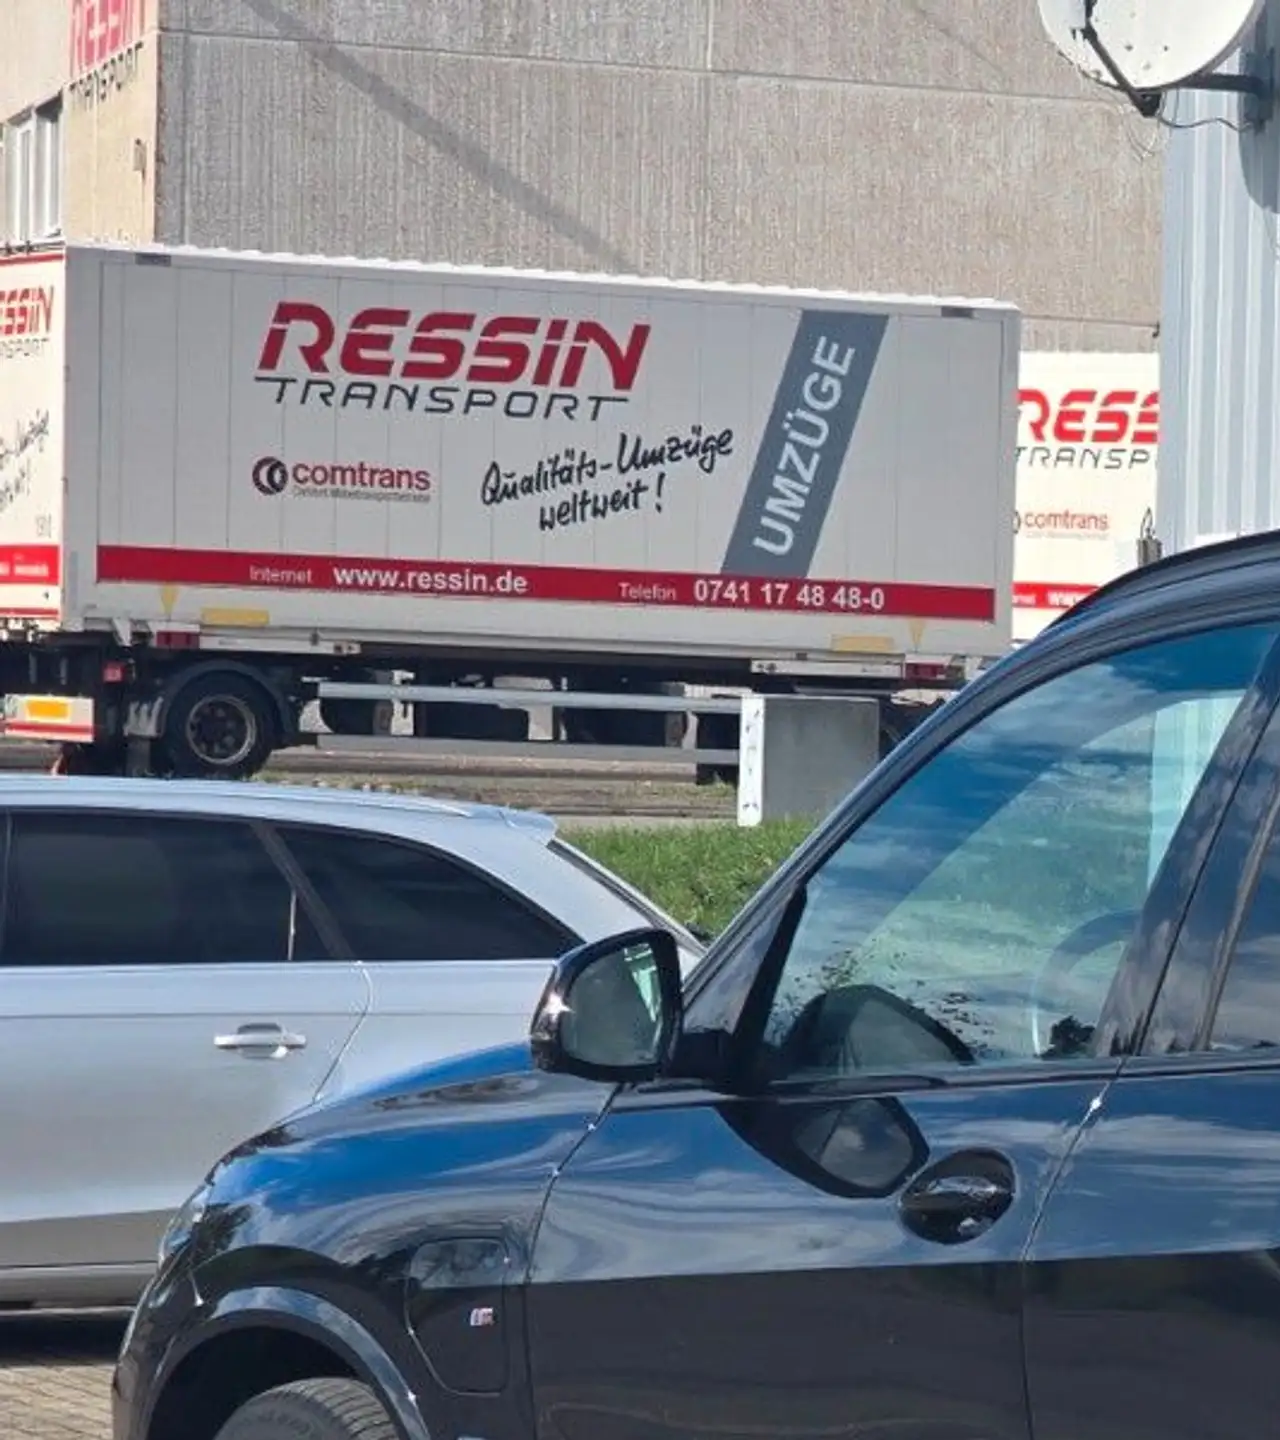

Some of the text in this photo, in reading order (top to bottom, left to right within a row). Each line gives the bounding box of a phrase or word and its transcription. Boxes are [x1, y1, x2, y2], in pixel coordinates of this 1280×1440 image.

[258, 301, 652, 390] RESSIN
[254, 376, 629, 421] TRANSPORT
[480, 424, 734, 506] Qualitäts-Umzüge
[752, 336, 856, 556] UMZÜGE
[291, 461, 431, 491] comtrans
[1025, 508, 1110, 531] comtrans
[249, 565, 529, 594] Internet www.ressin.de
[618, 579, 885, 611] Telefon 0741 17 48 48-0
